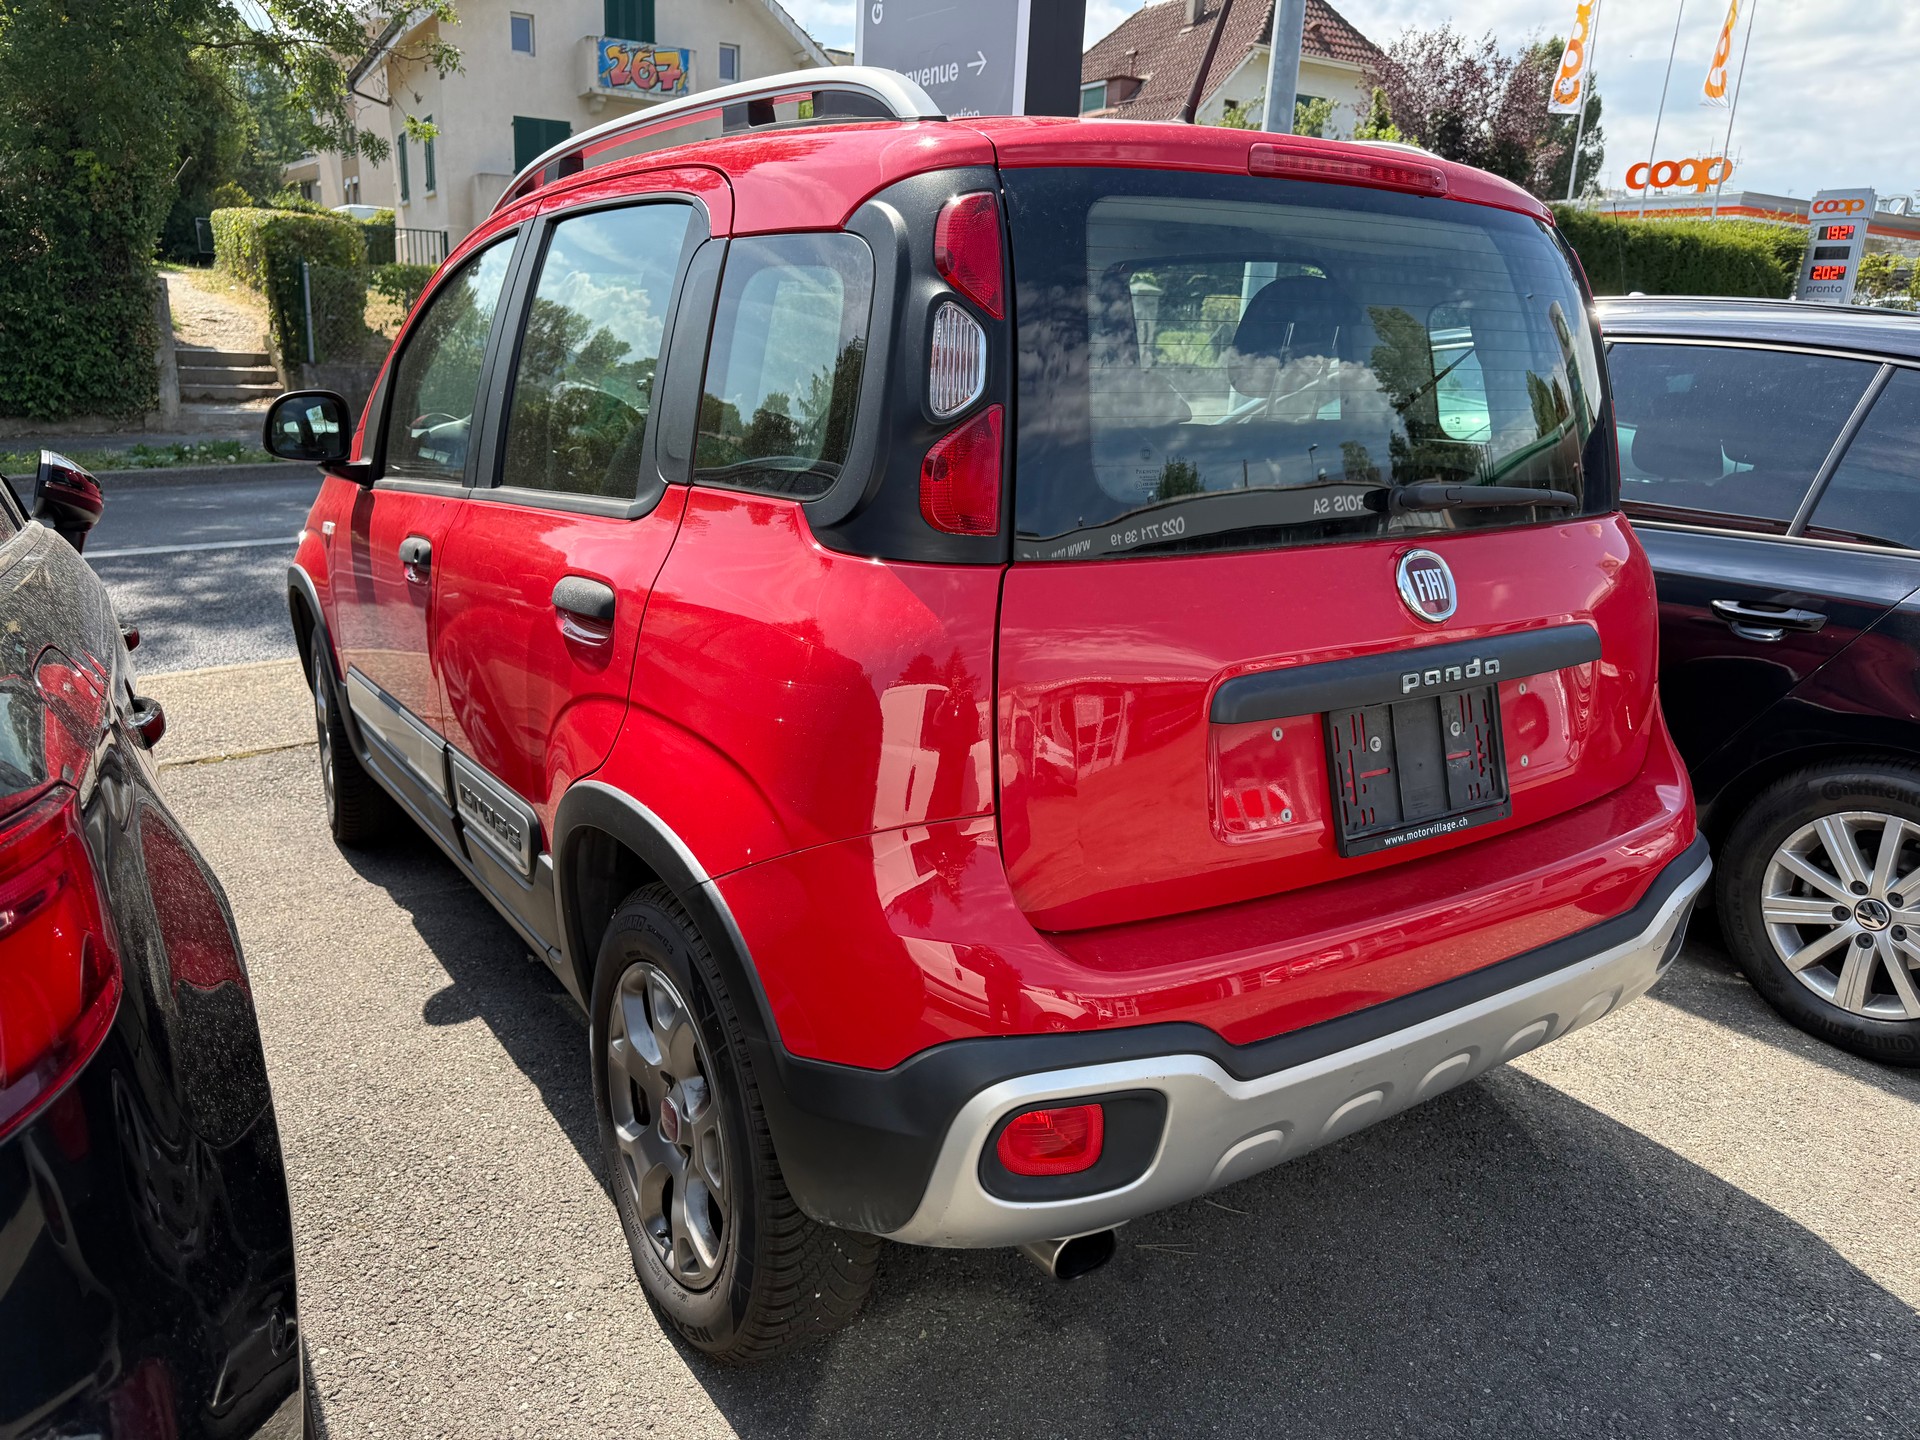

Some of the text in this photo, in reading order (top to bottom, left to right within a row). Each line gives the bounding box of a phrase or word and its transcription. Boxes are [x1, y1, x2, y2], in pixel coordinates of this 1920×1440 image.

[605, 44, 683, 92] 267
[1625, 156, 1733, 193] coop
[1812, 198, 1866, 216] coop
[1805, 284, 1843, 294] pronto
[1412, 568, 1447, 602] FIAT
[1402, 657, 1500, 694] panda
[1384, 817, 1469, 846] www.motorvillage.ch
